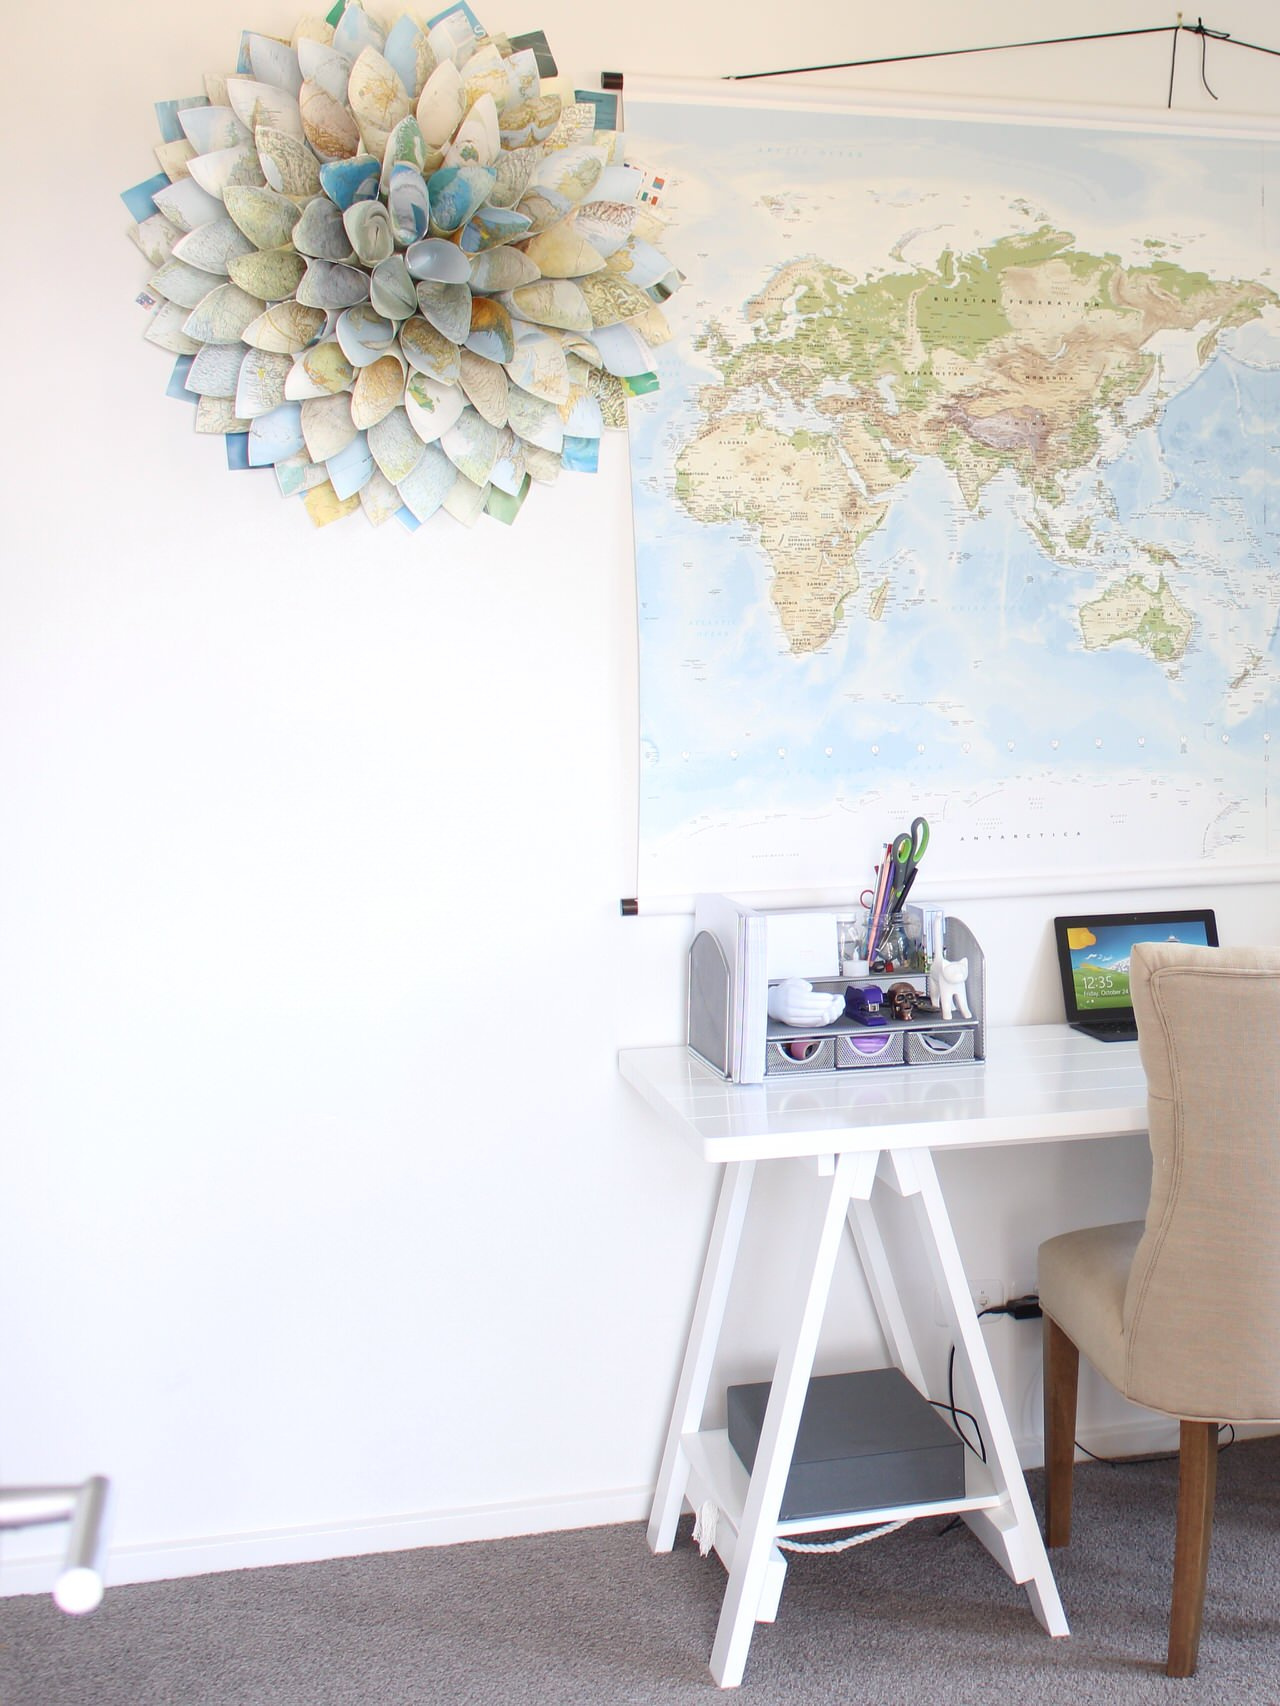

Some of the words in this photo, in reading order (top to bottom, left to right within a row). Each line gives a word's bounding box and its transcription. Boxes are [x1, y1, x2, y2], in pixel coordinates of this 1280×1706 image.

[933, 296, 998, 304] RUSSIAN
[1009, 299, 1101, 308] FEDERATION
[960, 832, 1081, 842] ANTARCTICA
[1083, 976, 1113, 989] 12:35
[1083, 990, 1099, 998] Friday,
[1101, 988, 1121, 997] October
